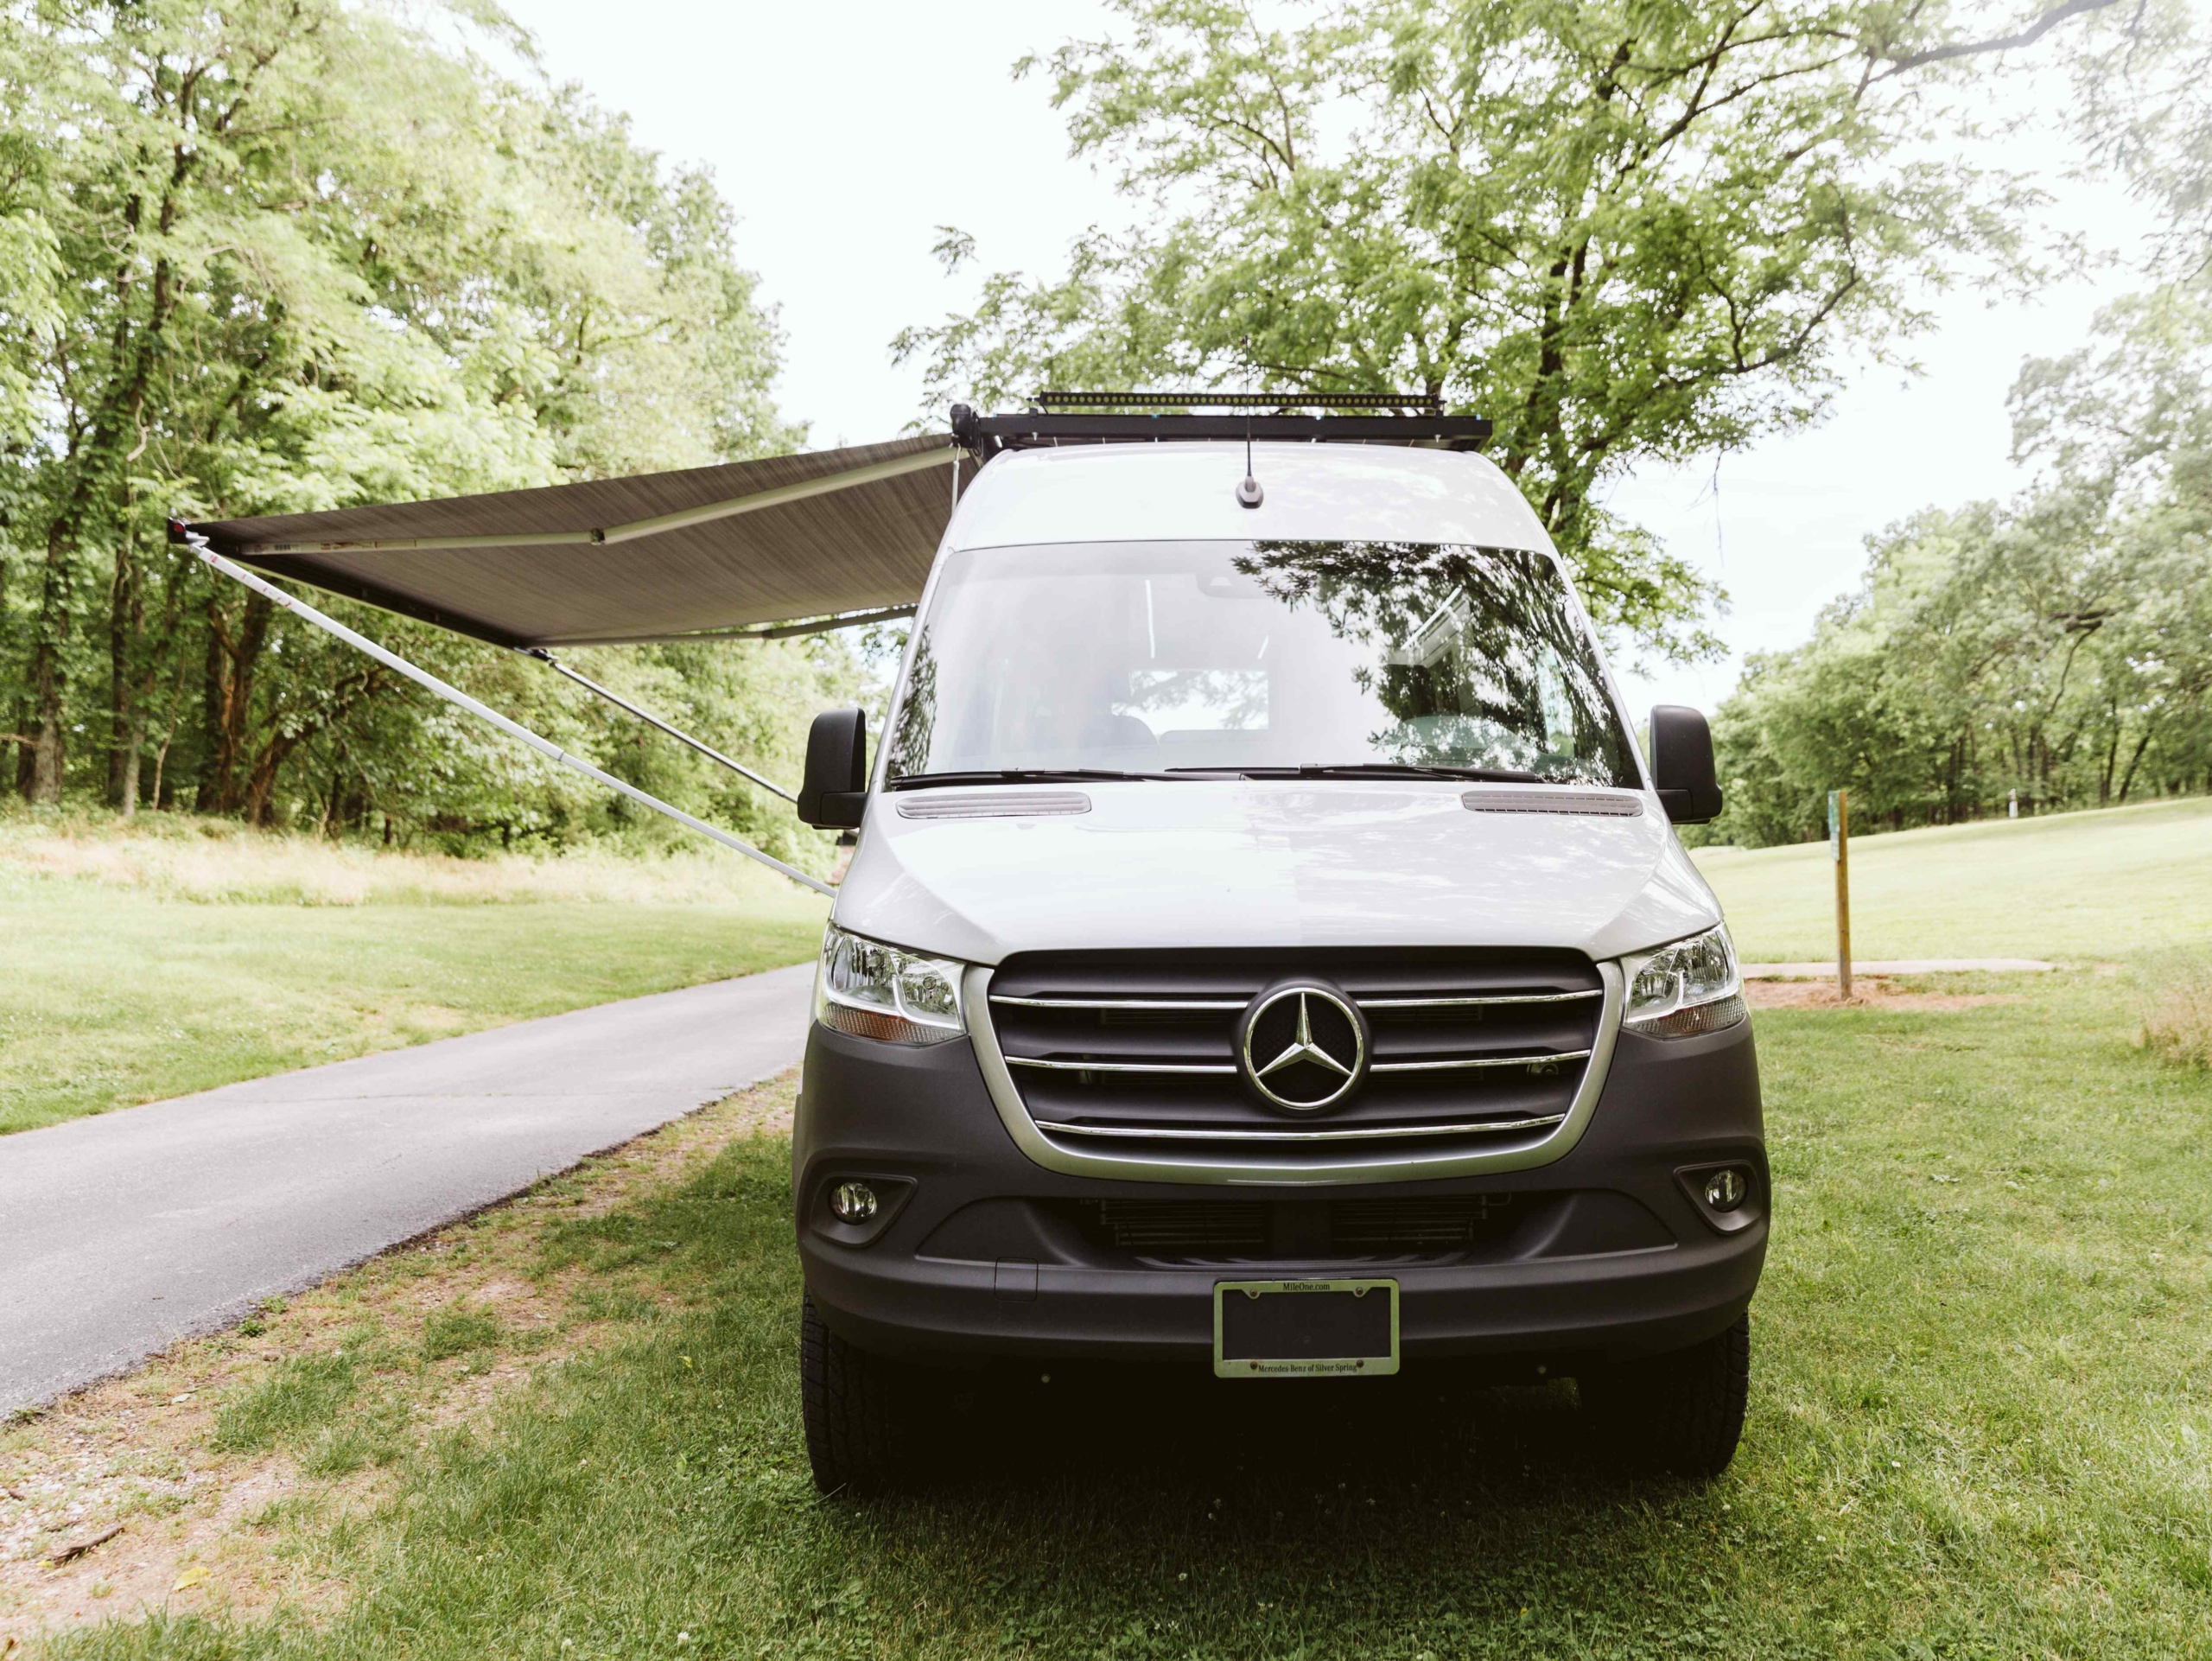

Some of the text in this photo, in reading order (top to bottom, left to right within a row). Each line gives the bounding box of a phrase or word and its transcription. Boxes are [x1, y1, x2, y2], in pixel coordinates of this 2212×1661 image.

[1283, 1282, 1330, 1291] MileOne.com
[1315, 1364, 1334, 1372] Silver
[1335, 1363, 1357, 1372] Spring
